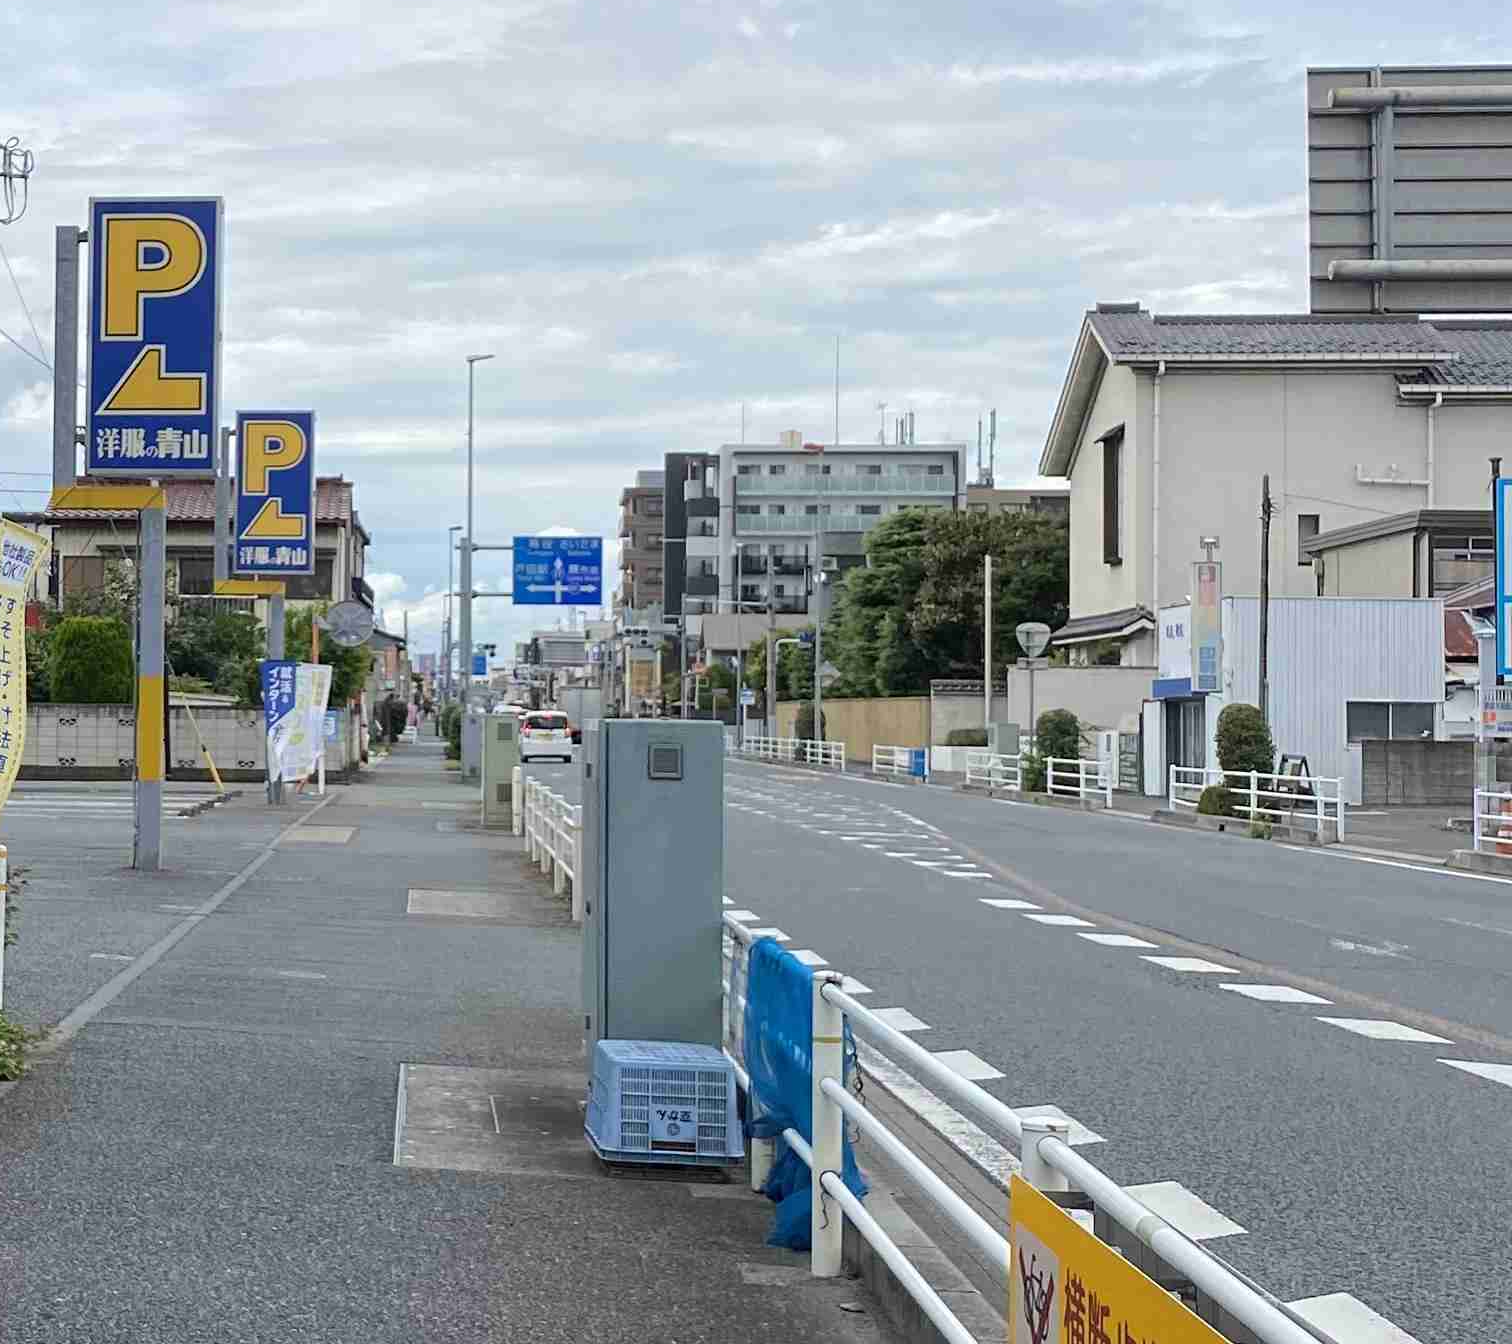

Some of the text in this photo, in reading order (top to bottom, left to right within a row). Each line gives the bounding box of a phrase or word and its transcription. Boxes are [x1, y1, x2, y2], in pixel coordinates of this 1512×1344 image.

[101, 213, 208, 342] P
[96, 427, 209, 459] 洋服の青山
[242, 420, 306, 496] P
[240, 546, 307, 566] 洋服の青山
[268, 666, 280, 723] インターン
